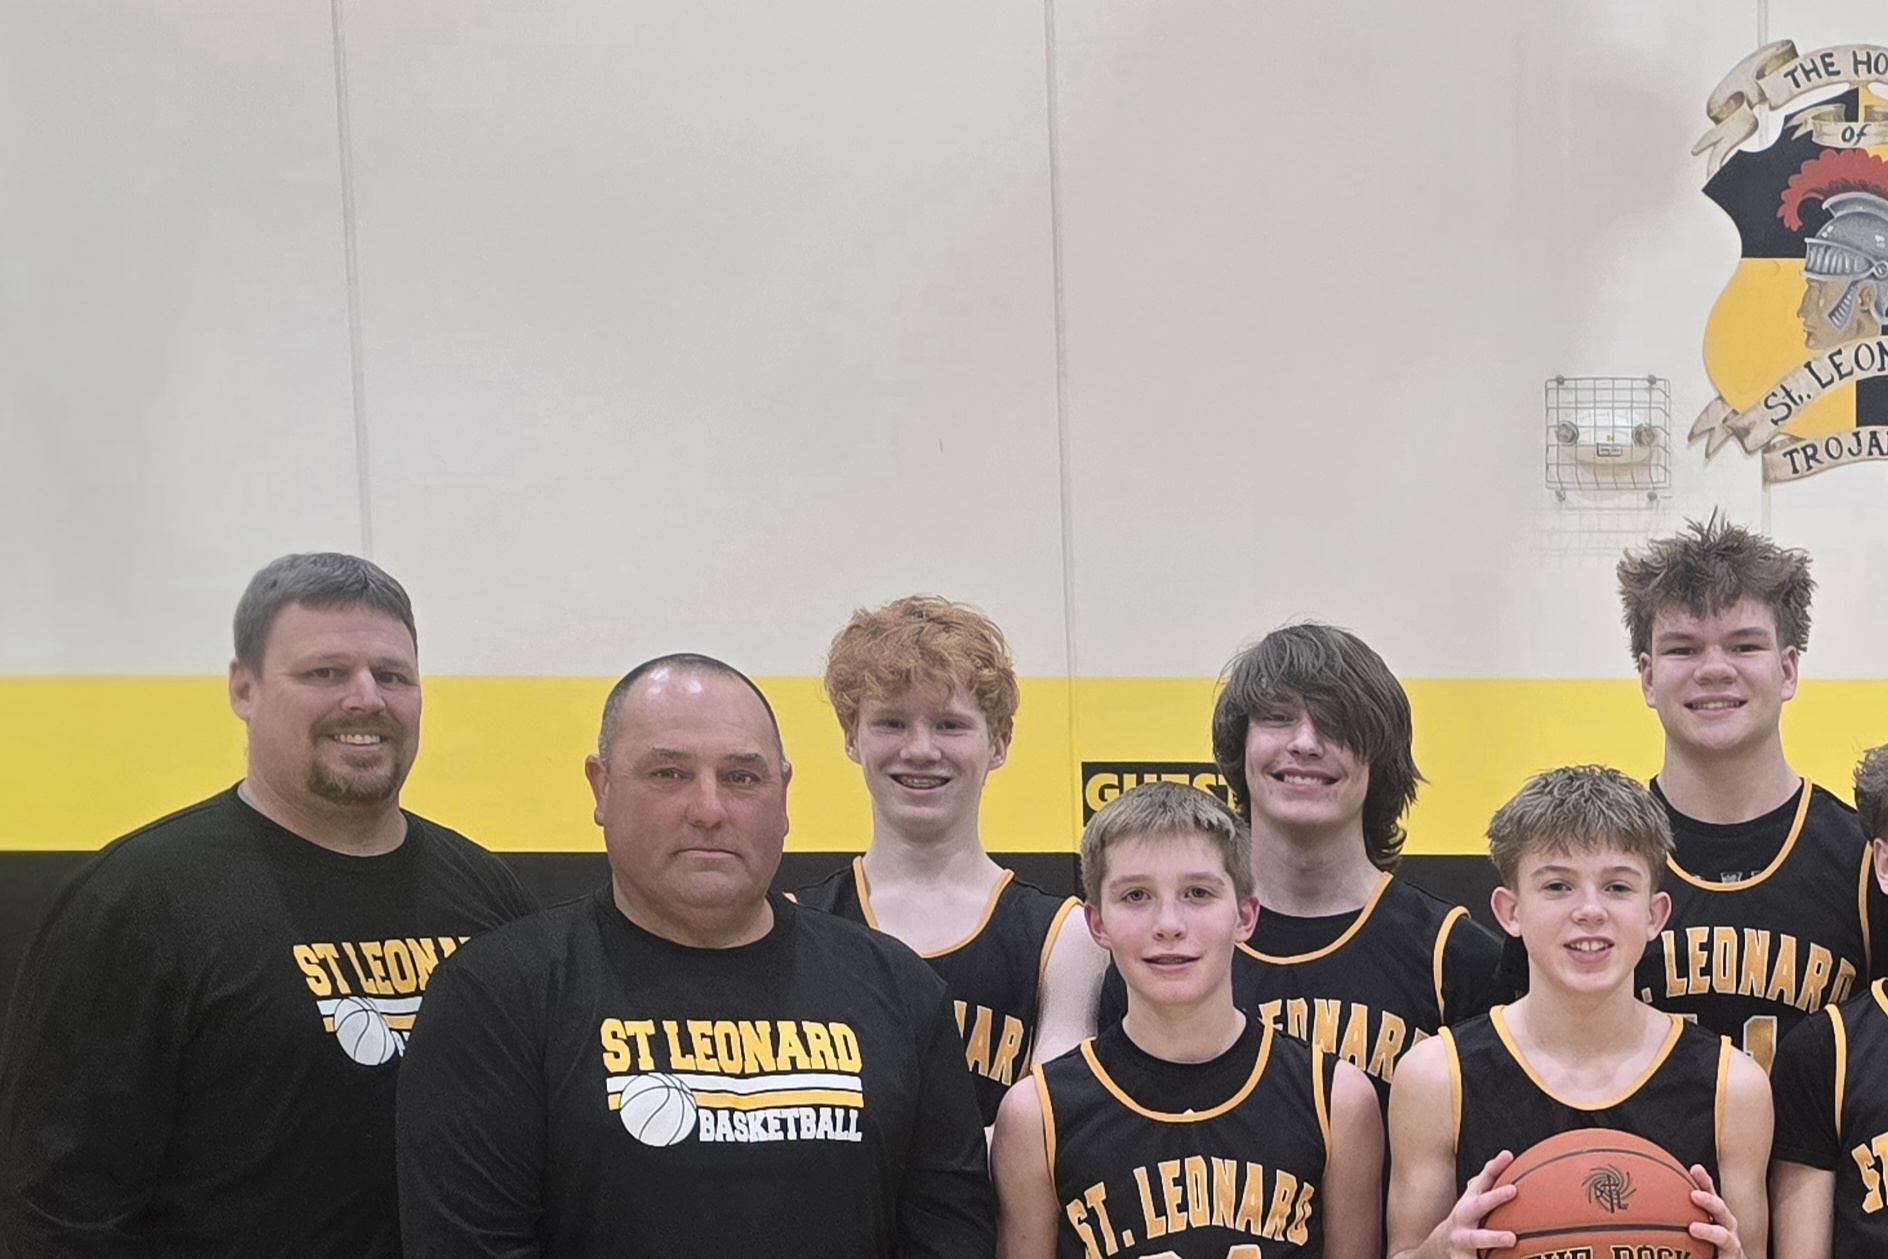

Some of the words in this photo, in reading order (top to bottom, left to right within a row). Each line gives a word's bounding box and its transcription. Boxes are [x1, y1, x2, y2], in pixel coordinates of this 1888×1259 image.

[1783, 52, 1841, 89] THE
[1763, 384, 1812, 426] St.
[293, 942, 352, 996] ST
[341, 936, 472, 995] LEON
[600, 1018, 656, 1073] ST
[662, 1019, 863, 1074] LEONARD
[698, 1107, 863, 1143] BASKETBALL
[1133, 1155, 1315, 1247] LEONARD
